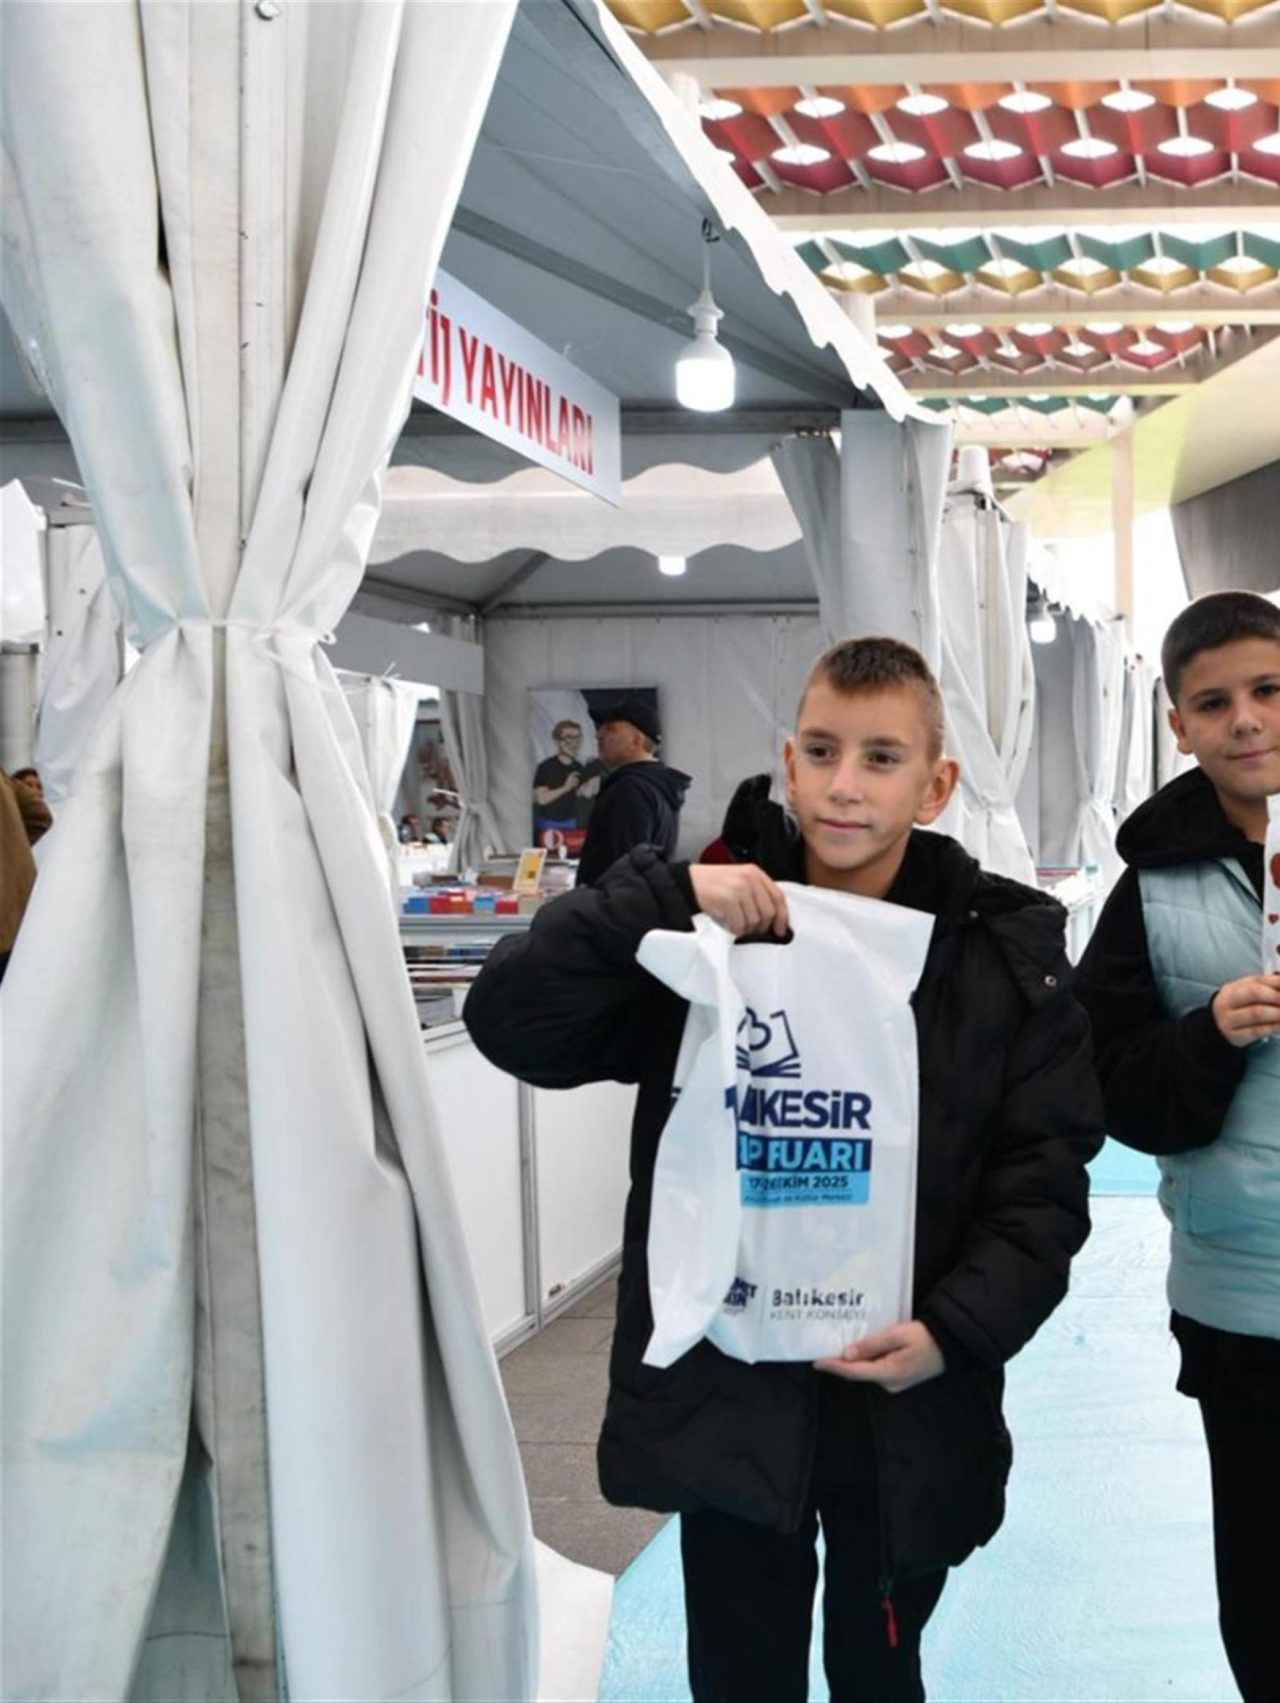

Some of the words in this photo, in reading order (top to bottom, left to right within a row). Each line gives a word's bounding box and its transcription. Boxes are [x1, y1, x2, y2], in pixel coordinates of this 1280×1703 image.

[416, 287, 452, 406] İJ
[458, 325, 594, 476] YAYINLARI
[767, 1141, 864, 1171] FUARI
[812, 1175, 849, 1189] 2025
